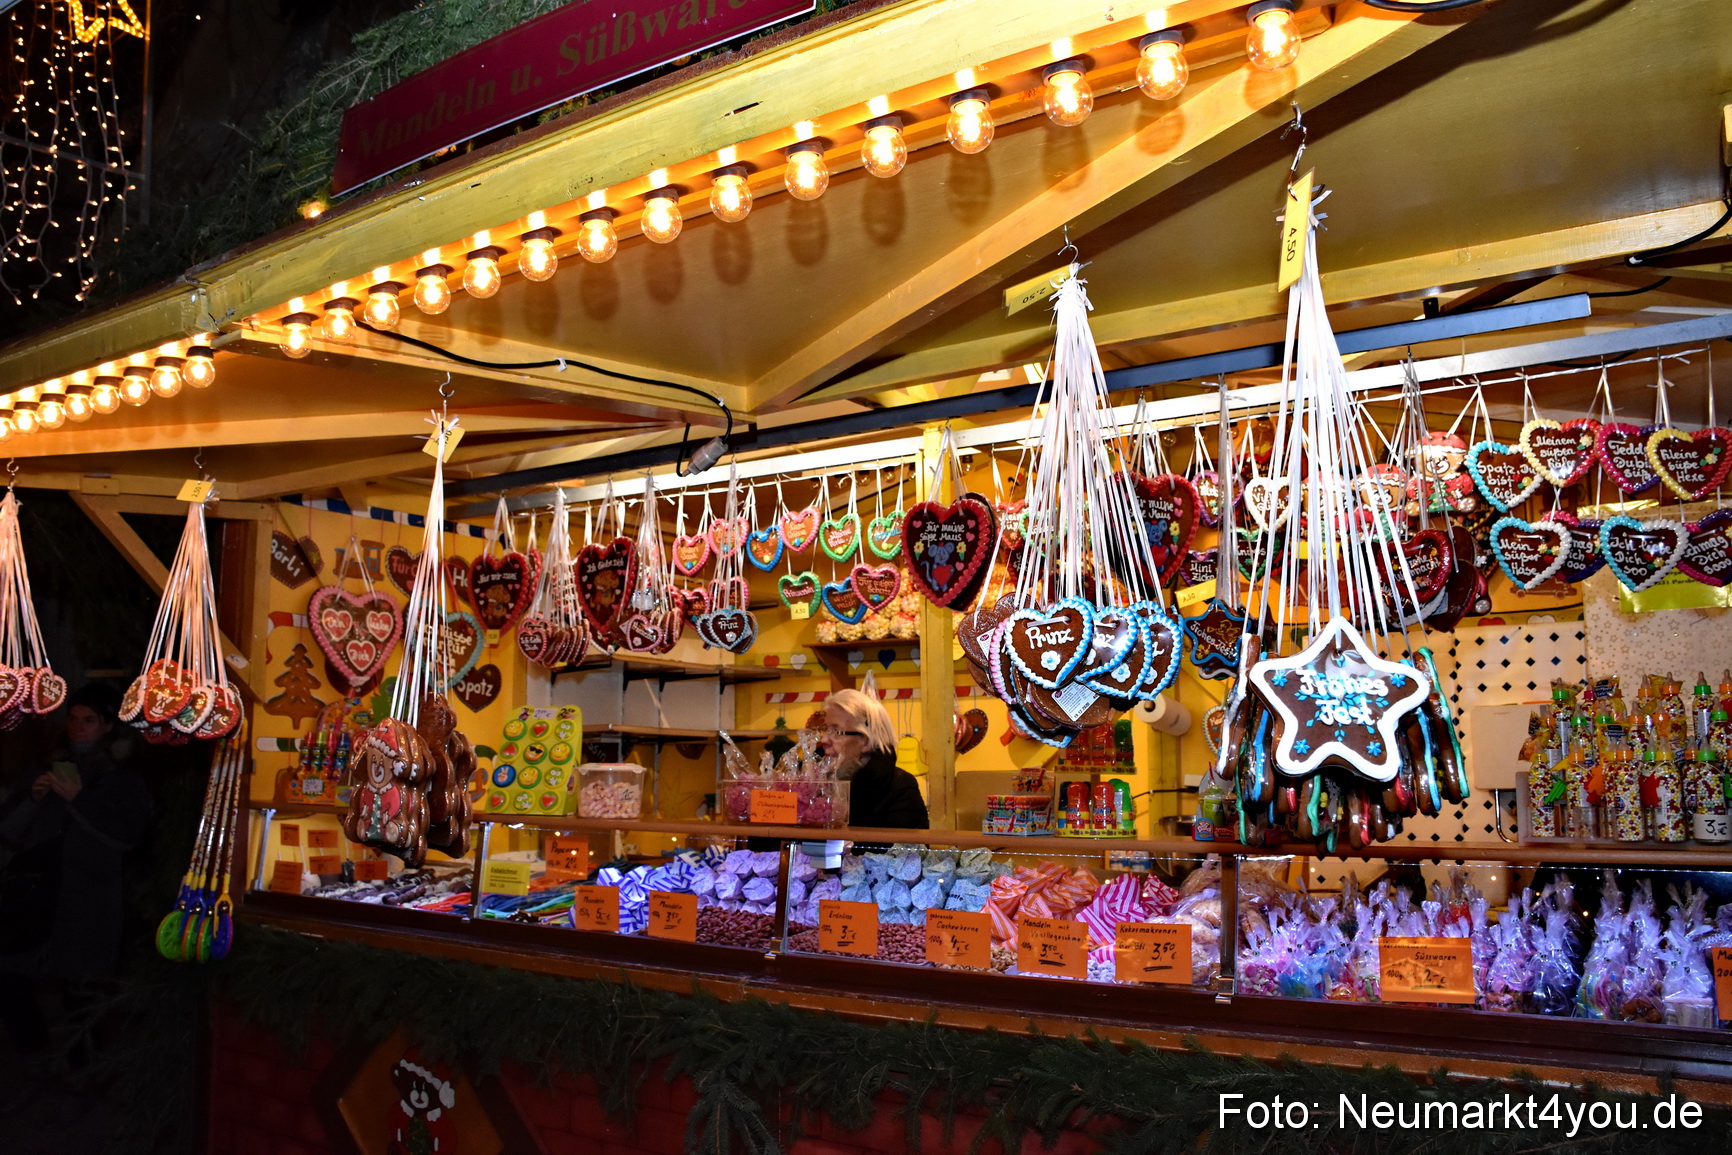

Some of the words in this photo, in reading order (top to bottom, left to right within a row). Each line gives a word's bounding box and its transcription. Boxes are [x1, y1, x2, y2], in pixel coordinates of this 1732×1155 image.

[358, 78, 497, 156] Mandeln
[510, 64, 542, 96] u.
[1607, 440, 1648, 455] Tedd
[1660, 449, 1700, 461] Kleine
[1675, 471, 1707, 483] Hexe
[1499, 538, 1535, 551] Mein
[1614, 550, 1647, 566] Dich
[1691, 547, 1727, 566] Dich
[1511, 562, 1540, 576] Hase
[1025, 625, 1075, 650] Prinz
[1295, 667, 1389, 698] Frohes
[1315, 696, 1376, 726] Fest
[1022, 918, 1051, 929] Mandeln
[1119, 924, 1178, 935] Kokosmakronen
[1414, 951, 1457, 961] Süsswaren
